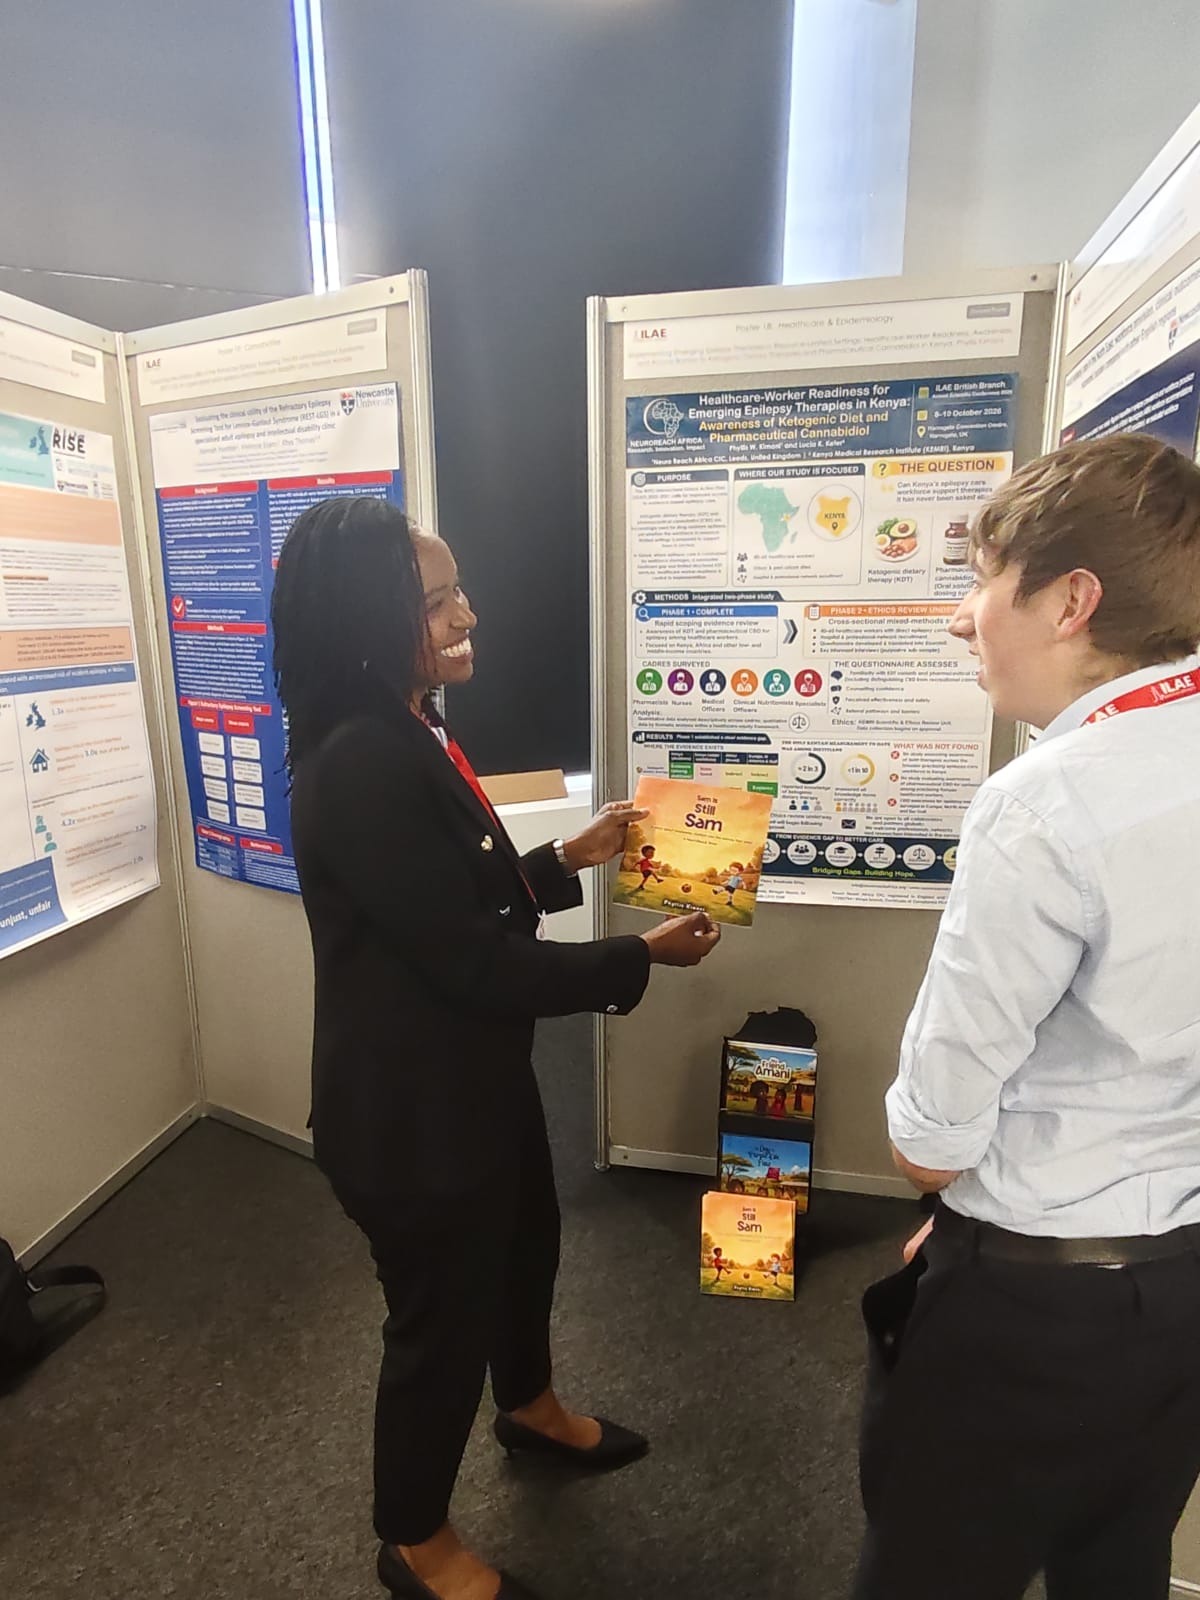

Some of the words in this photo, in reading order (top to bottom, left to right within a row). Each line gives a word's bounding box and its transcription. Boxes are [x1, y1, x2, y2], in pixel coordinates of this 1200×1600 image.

[827, 318, 833, 326] &
[836, 315, 894, 327] Epidemiology
[640, 328, 668, 339] ILAE
[935, 383, 952, 392] ILAE
[954, 382, 978, 391] British
[979, 380, 1006, 389] Branch
[355, 387, 395, 399] Newcastle
[699, 389, 806, 406] Healthcare-Worker
[808, 386, 871, 400] Readiness
[873, 384, 891, 396] for
[279, 402, 307, 411] Refractory
[308, 400, 332, 409] Epilepsy
[356, 397, 394, 409] University
[688, 407, 742, 420] Emerging
[744, 404, 793, 417] Epilepsy
[795, 400, 854, 414] Therapies
[856, 398, 867, 409] in
[869, 396, 911, 410] Kenya:
[952, 407, 983, 418] October
[699, 418, 761, 432] Awareness
[763, 416, 776, 427] of
[778, 413, 837, 428] Ketogenic
[840, 411, 864, 424] Diet
[866, 410, 889, 422] and
[709, 429, 798, 444] Pharmaceutical
[800, 425, 870, 440] Cannabidiol
[53, 432, 86, 454] RISE
[629, 438, 676, 447] NEUROREACH
[677, 437, 703, 445] AFRICA
[673, 457, 692, 465] Reach
[750, 453, 771, 461] United
[772, 451, 802, 461] Kingdom
[812, 450, 834, 458] Kenya
[863, 448, 895, 456] Research
[895, 446, 922, 454] Institute
[952, 444, 975, 452] Kenya
[900, 462, 925, 473] THE
[927, 459, 995, 472] QUESTION
[738, 469, 767, 478] WHERE
[767, 469, 785, 477] OUR
[786, 468, 811, 476] STUDY
[812, 467, 820, 475] IS
[821, 465, 859, 475] FOCUSED
[657, 473, 692, 482] PURPOSE
[912, 480, 939, 489] Kenya's
[940, 480, 969, 488] epilepsy
[932, 486, 960, 495] support
[824, 512, 846, 520] KENYA
[867, 568, 901, 577] Ketogenic
[902, 567, 926, 575] dietary
[867, 576, 893, 584] therapy
[893, 576, 913, 584] (KDT)
[934, 582, 952, 590] (Oral
[654, 593, 690, 602] METHODS
[692, 593, 724, 602] Integrated
[757, 593, 775, 602] study
[934, 589, 957, 597] dosing
[661, 608, 685, 616] PHASE
[686, 608, 691, 616] 1
[695, 608, 735, 616] COMPLETE
[830, 607, 857, 615] PHASE
[857, 607, 863, 615] 2
[868, 607, 897, 615] ETHICS
[898, 606, 928, 615] REVIEW
[654, 619, 674, 628] Rapid
[675, 619, 702, 628] scoping
[703, 619, 735, 627] evidence
[886, 617, 944, 625] mixed-methods
[642, 660, 671, 668] CADRES
[672, 660, 711, 668] SURVEYED
[850, 660, 915, 668] QUESTIONNAIRE
[1159, 674, 1195, 694] ILAE
[633, 699, 669, 707] Pharmacists
[671, 699, 692, 707] Nurses
[701, 698, 725, 706] Medical
[733, 698, 756, 706] Clinical
[632, 708, 662, 717] Analysis:
[701, 706, 726, 714] Officers
[733, 706, 758, 714] Officers
[893, 743, 915, 751] WHAT
[916, 743, 934, 751] WAS
[934, 743, 951, 751] NOT
[951, 743, 979, 751] FOUND
[697, 794, 712, 804] Sam
[694, 803, 716, 816] Still
[684, 813, 723, 833] Sam
[822, 834, 835, 842] GAP
[811, 866, 842, 876] Bridging
[864, 868, 894, 878] Building
[894, 870, 917, 879] Hope.
[0, 911, 28, 928] unjust,
[29, 900, 51, 916] unfair
[761, 1060, 786, 1070] Friend
[755, 1065, 791, 1079] Amani
[742, 1212, 756, 1221] Still
[737, 1220, 762, 1233] Sam
